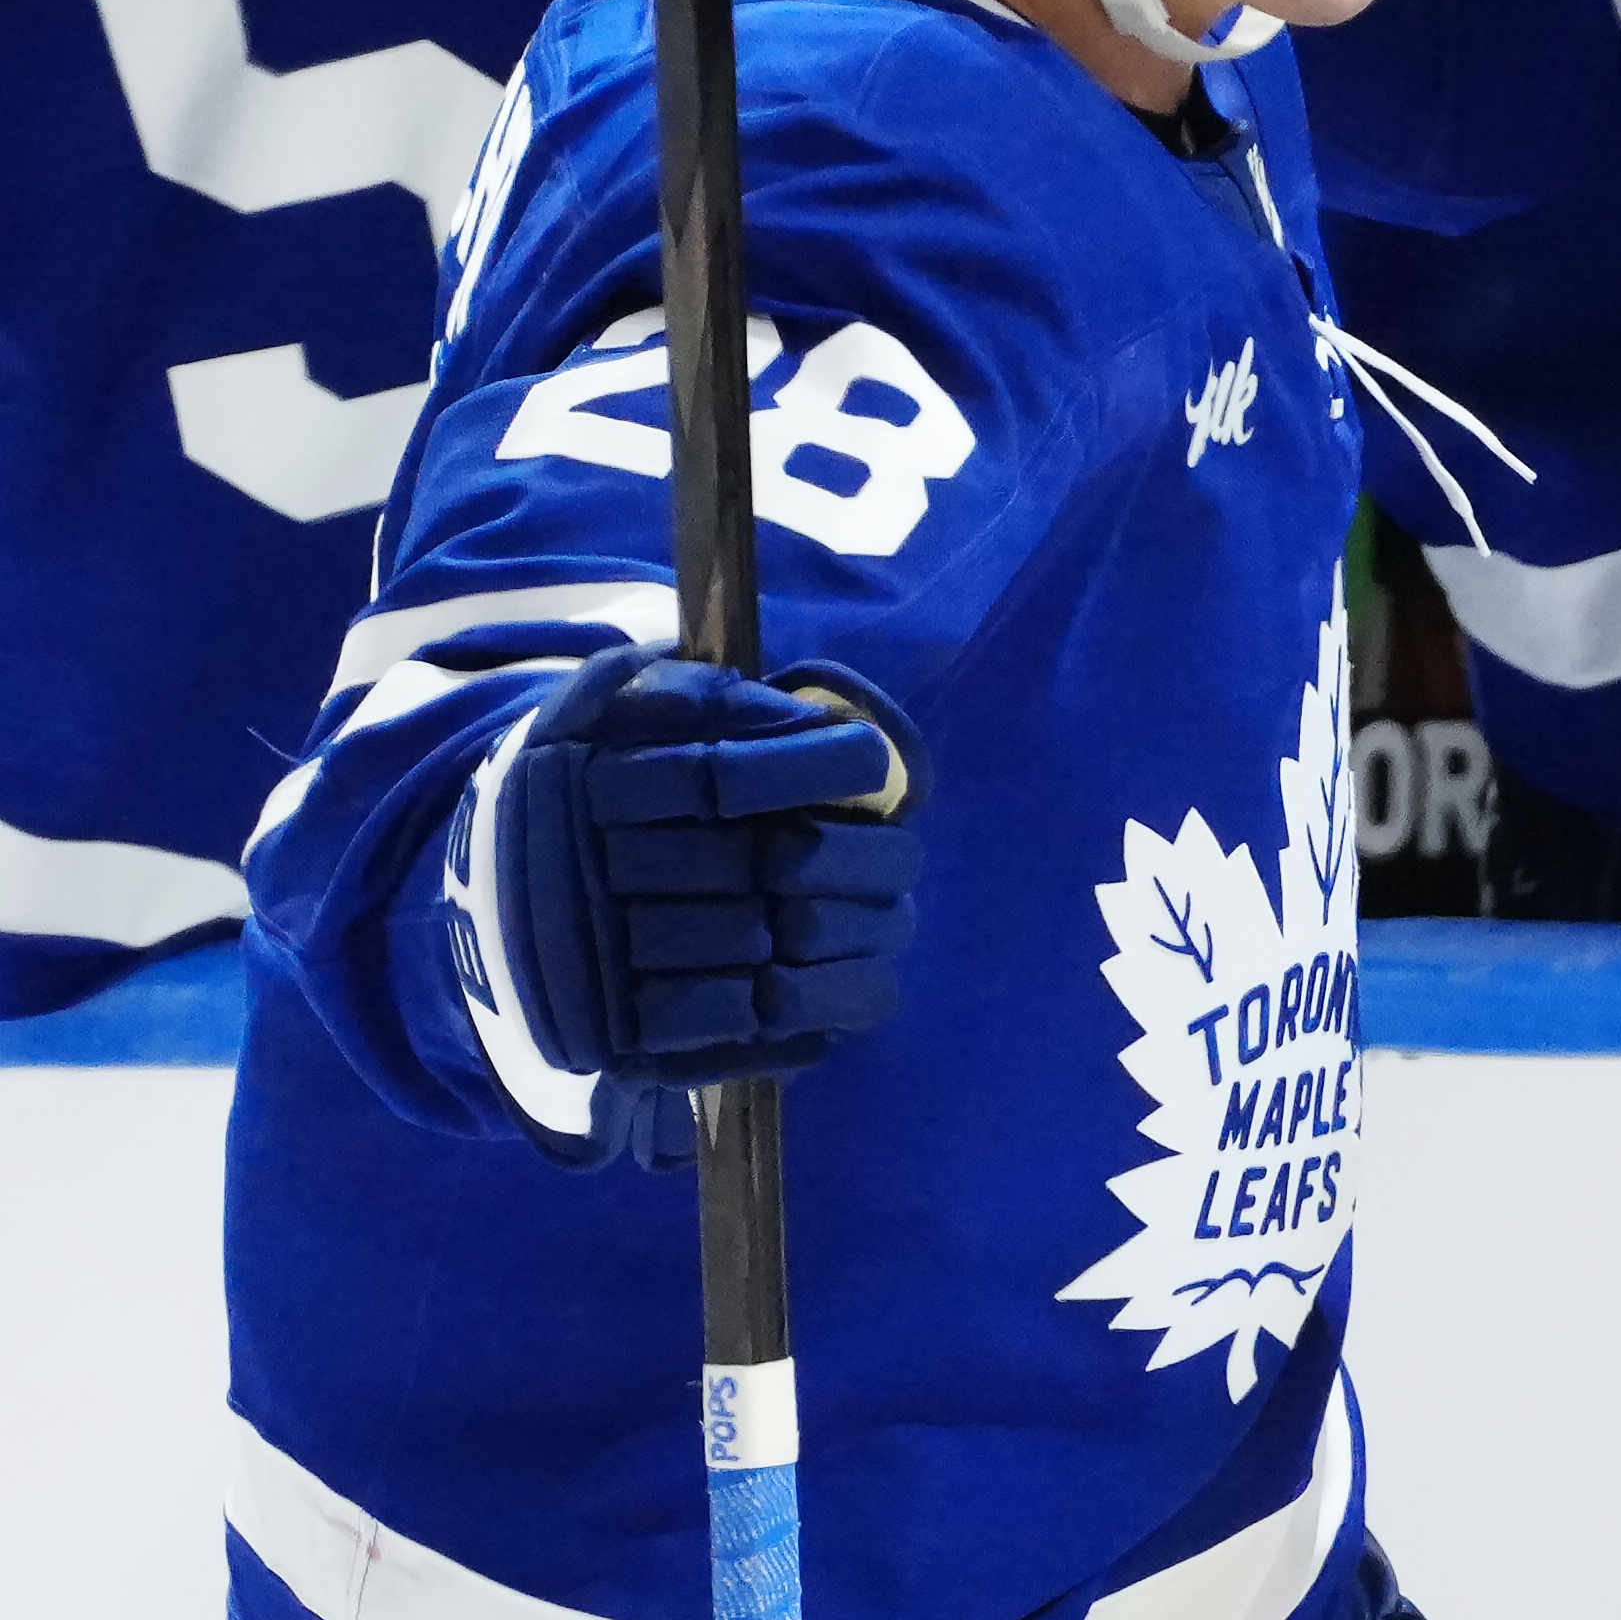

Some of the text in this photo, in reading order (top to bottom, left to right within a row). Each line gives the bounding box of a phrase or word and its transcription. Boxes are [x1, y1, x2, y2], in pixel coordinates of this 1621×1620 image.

[495, 305, 976, 558] 28
[1217, 1060, 1351, 1151] MAPLE
[1194, 1150, 1341, 1240] LEAFS
[711, 1375, 738, 1462] POPS
